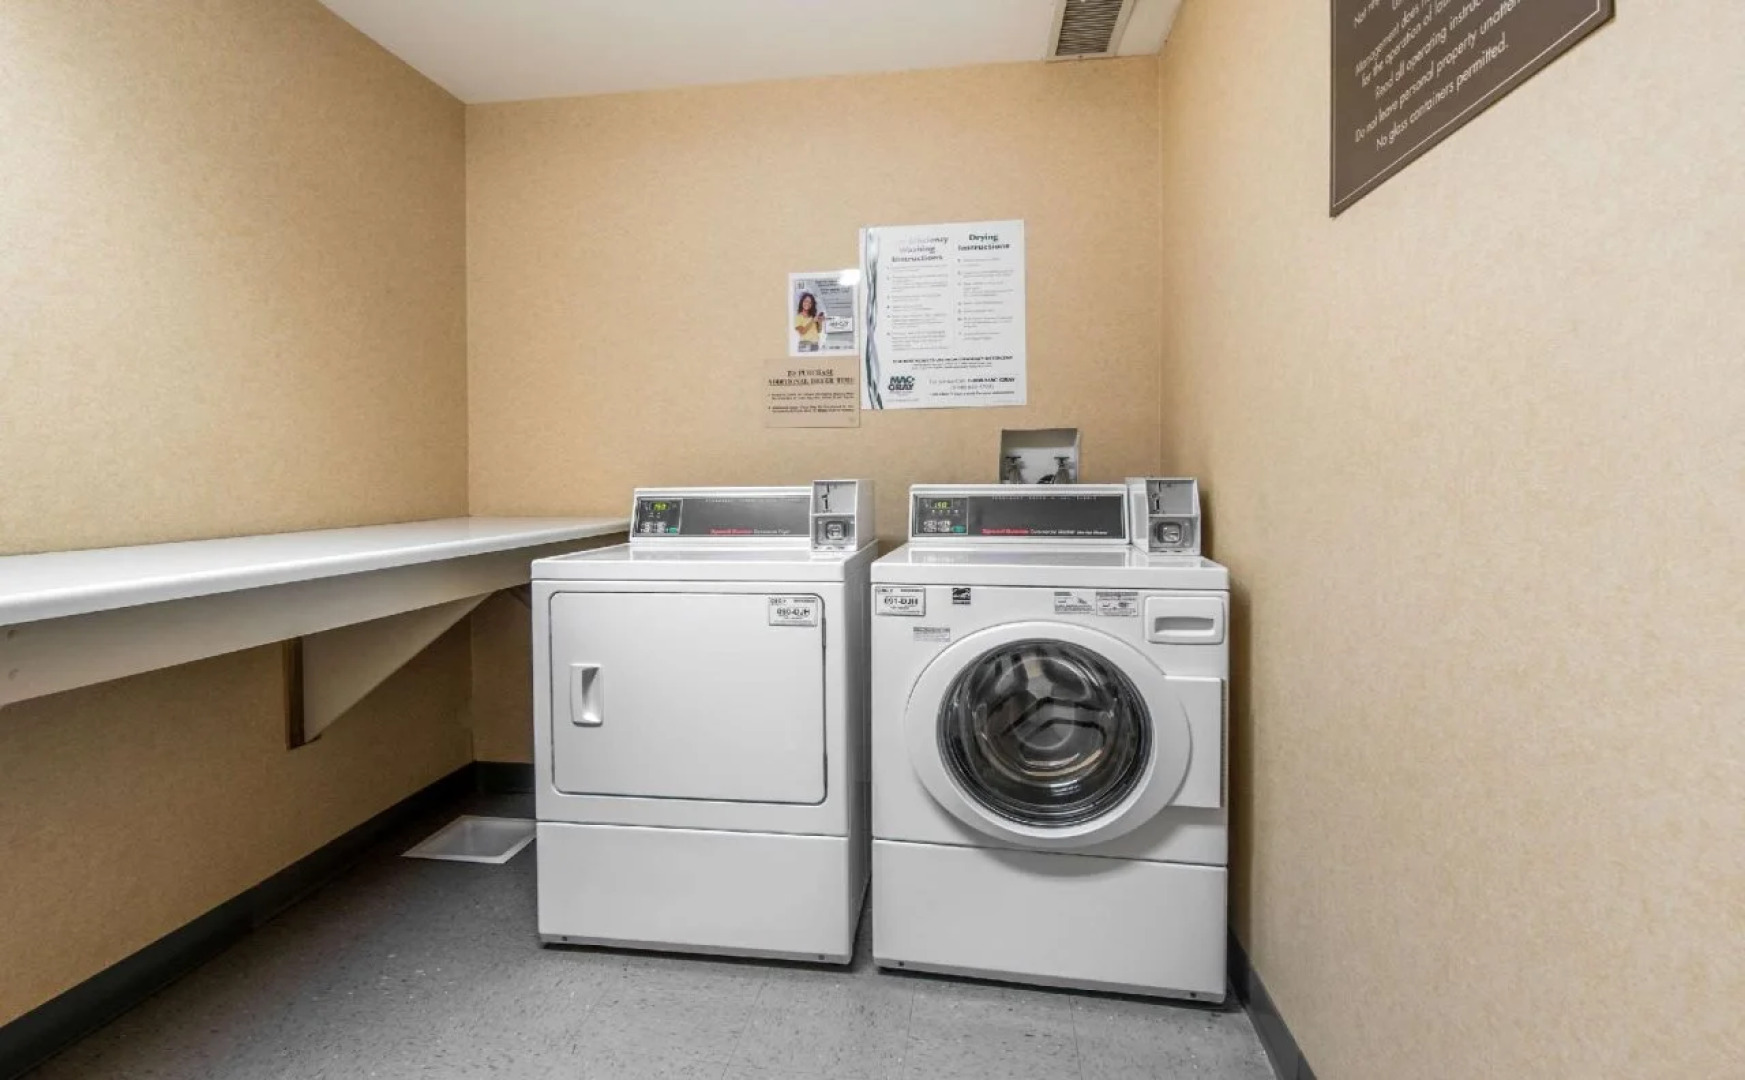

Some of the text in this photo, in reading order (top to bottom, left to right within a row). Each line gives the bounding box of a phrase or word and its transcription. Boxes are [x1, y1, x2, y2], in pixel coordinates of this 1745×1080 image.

[1355, 22, 1400, 77] Management
[1401, 4, 1420, 28] does
[1373, 60, 1384, 77] the
[1384, 22, 1422, 65] operation
[1423, 3, 1433, 26] of
[1375, 70, 1394, 100] Read
[1395, 60, 1405, 81] all
[1406, 26, 1447, 71] operating
[1355, 128, 1366, 143] Do
[1366, 114, 1378, 134] not
[1378, 106, 1399, 123] leave
[1400, 60, 1434, 110] personal
[1437, 29, 1477, 80] property
[1376, 31, 1509, 151] No glass containers permitted.
[957, 243, 1010, 251] Instructions
[968, 233, 999, 242] Drying
